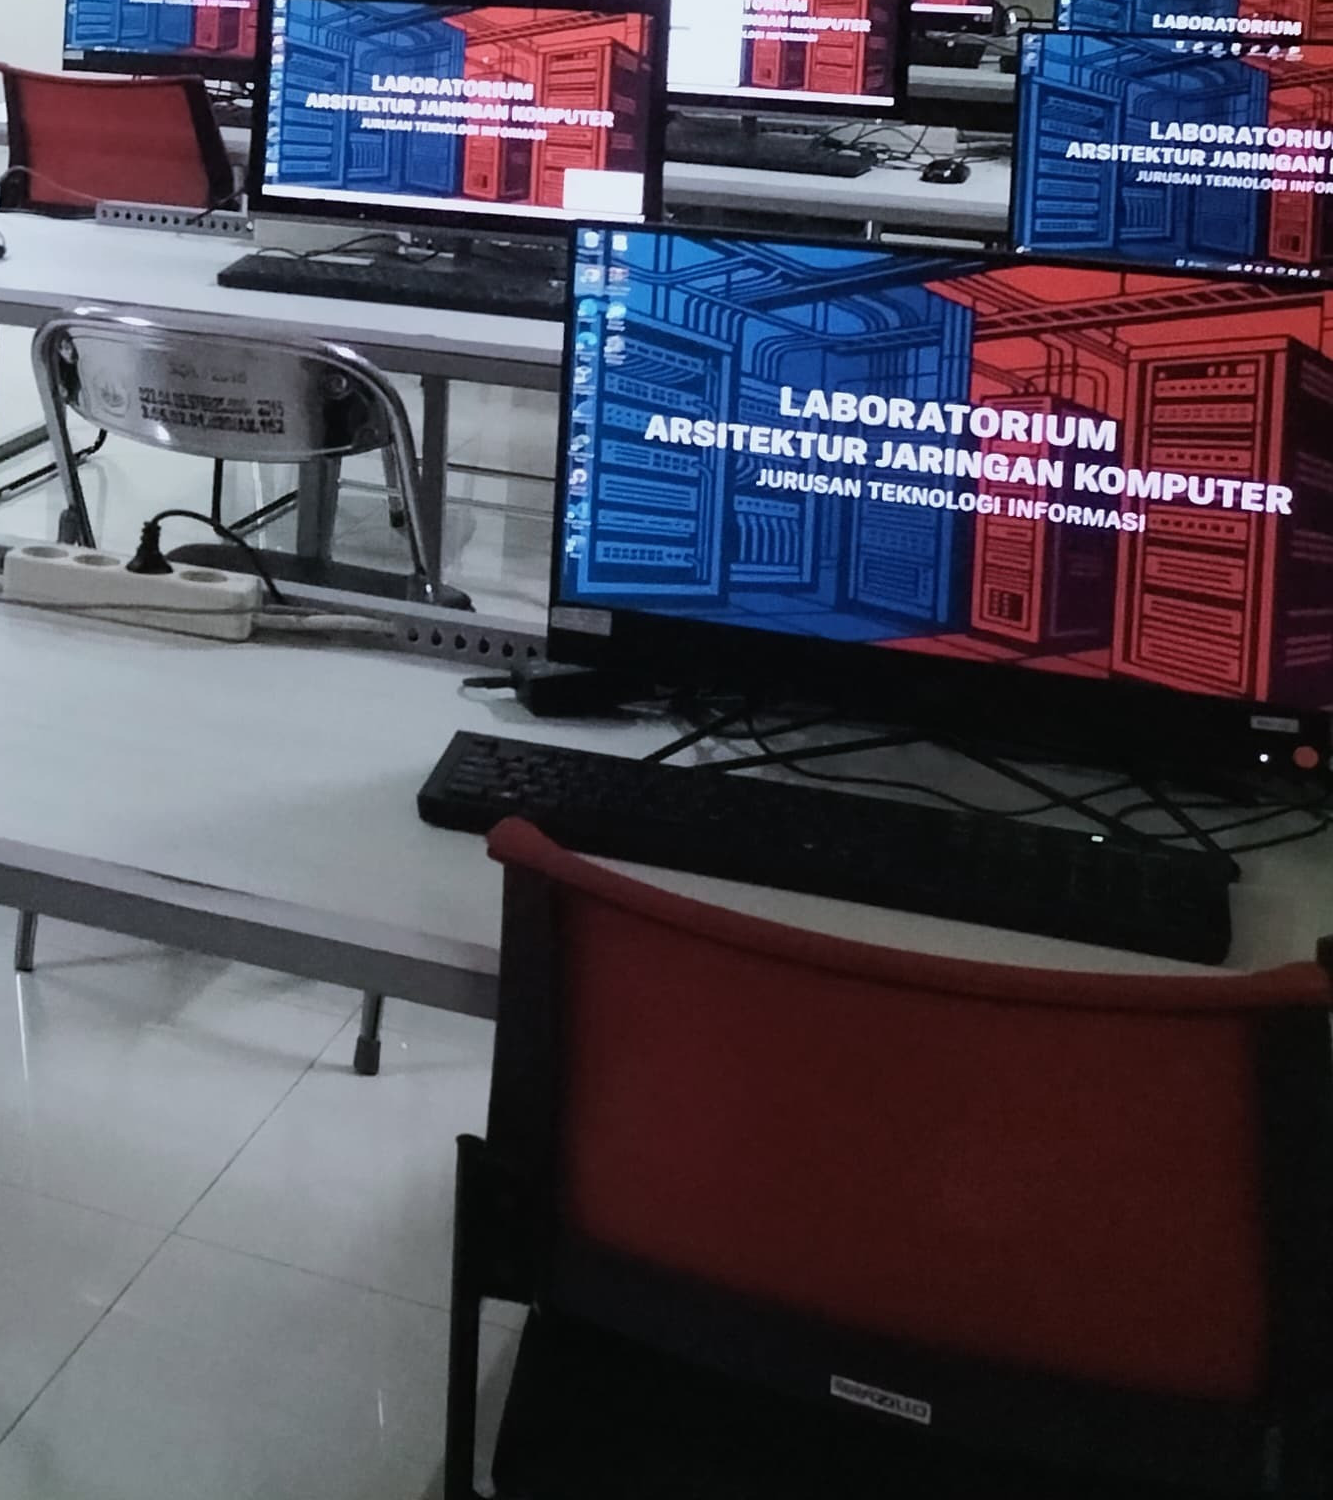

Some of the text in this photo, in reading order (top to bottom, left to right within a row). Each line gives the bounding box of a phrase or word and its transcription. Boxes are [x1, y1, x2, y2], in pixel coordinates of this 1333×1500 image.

[790, 16, 871, 32] KOMPUTER
[1152, 13, 1302, 36] LABORATORIUM
[372, 75, 534, 100] LABORATORIUM
[305, 92, 614, 127] ARSITEKTUR JARINGAN KOMPUTER
[1150, 121, 1333, 150] LABORATORIU
[1066, 142, 1325, 174] ARSITEKTUR JARINGAN
[1136, 169, 1333, 194] JURUSAN TEKNOLOGI INFOR
[779, 386, 1117, 451] LABORATORIUM
[645, 413, 1293, 515] ARSITEKTUR JARINGAN KOMPUTER
[756, 468, 1147, 533] JURUSAN TEKNOLOGI INFORMASI
